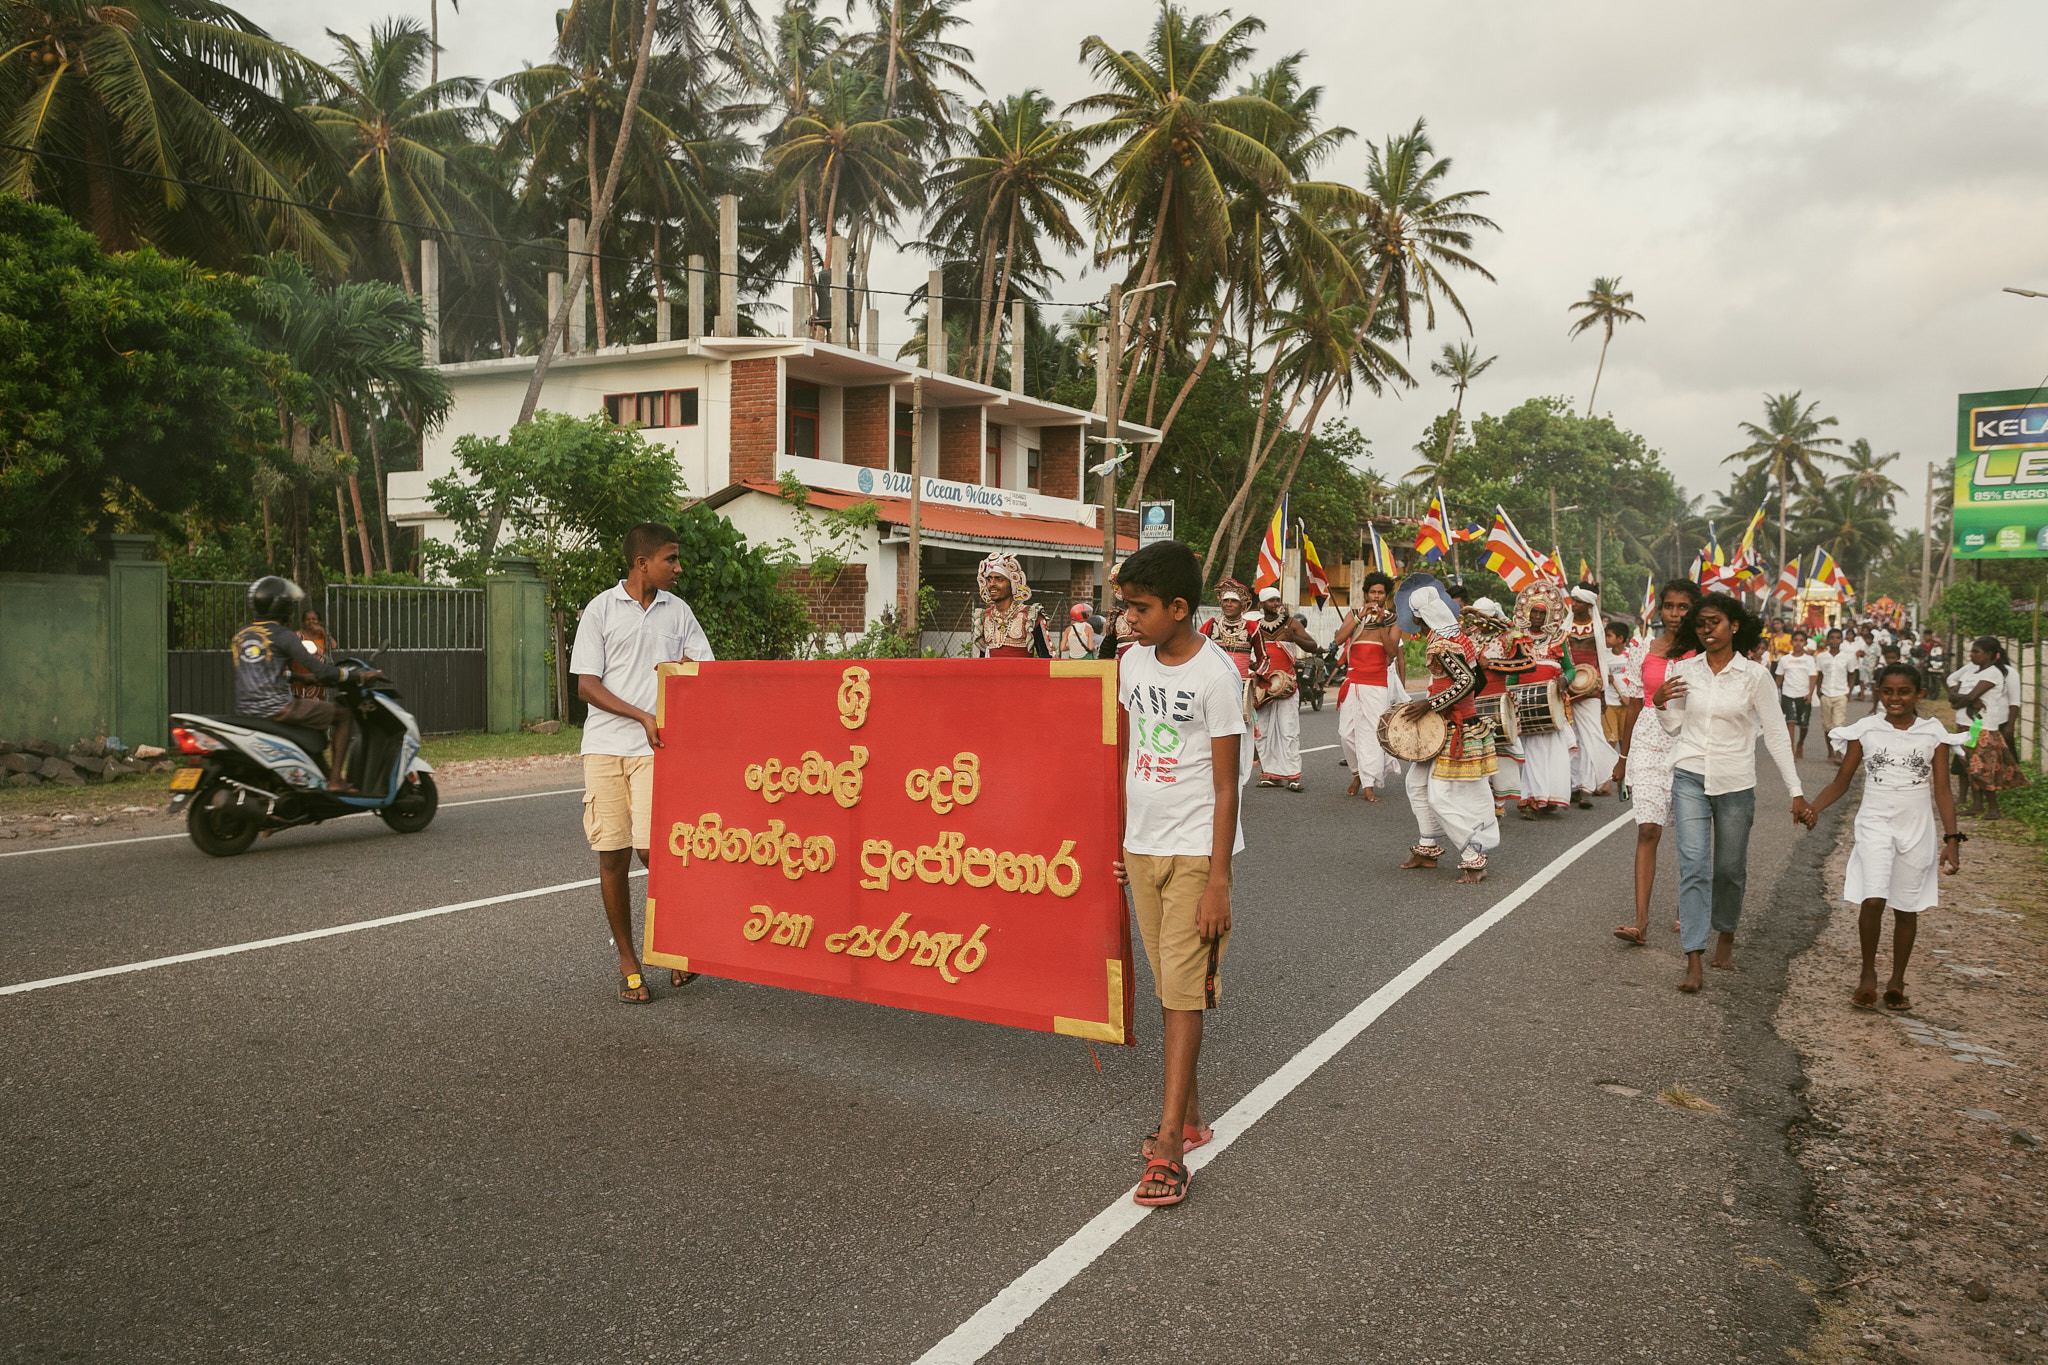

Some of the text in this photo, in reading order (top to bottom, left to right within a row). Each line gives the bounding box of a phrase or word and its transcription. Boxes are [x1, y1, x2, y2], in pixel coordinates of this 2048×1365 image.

[882, 472, 914, 493] Vill
[926, 479, 962, 502] Ocean
[966, 485, 1003, 507] Waves
[1974, 491, 2002, 501] 85%
[905, 751, 981, 815] දෙවි
